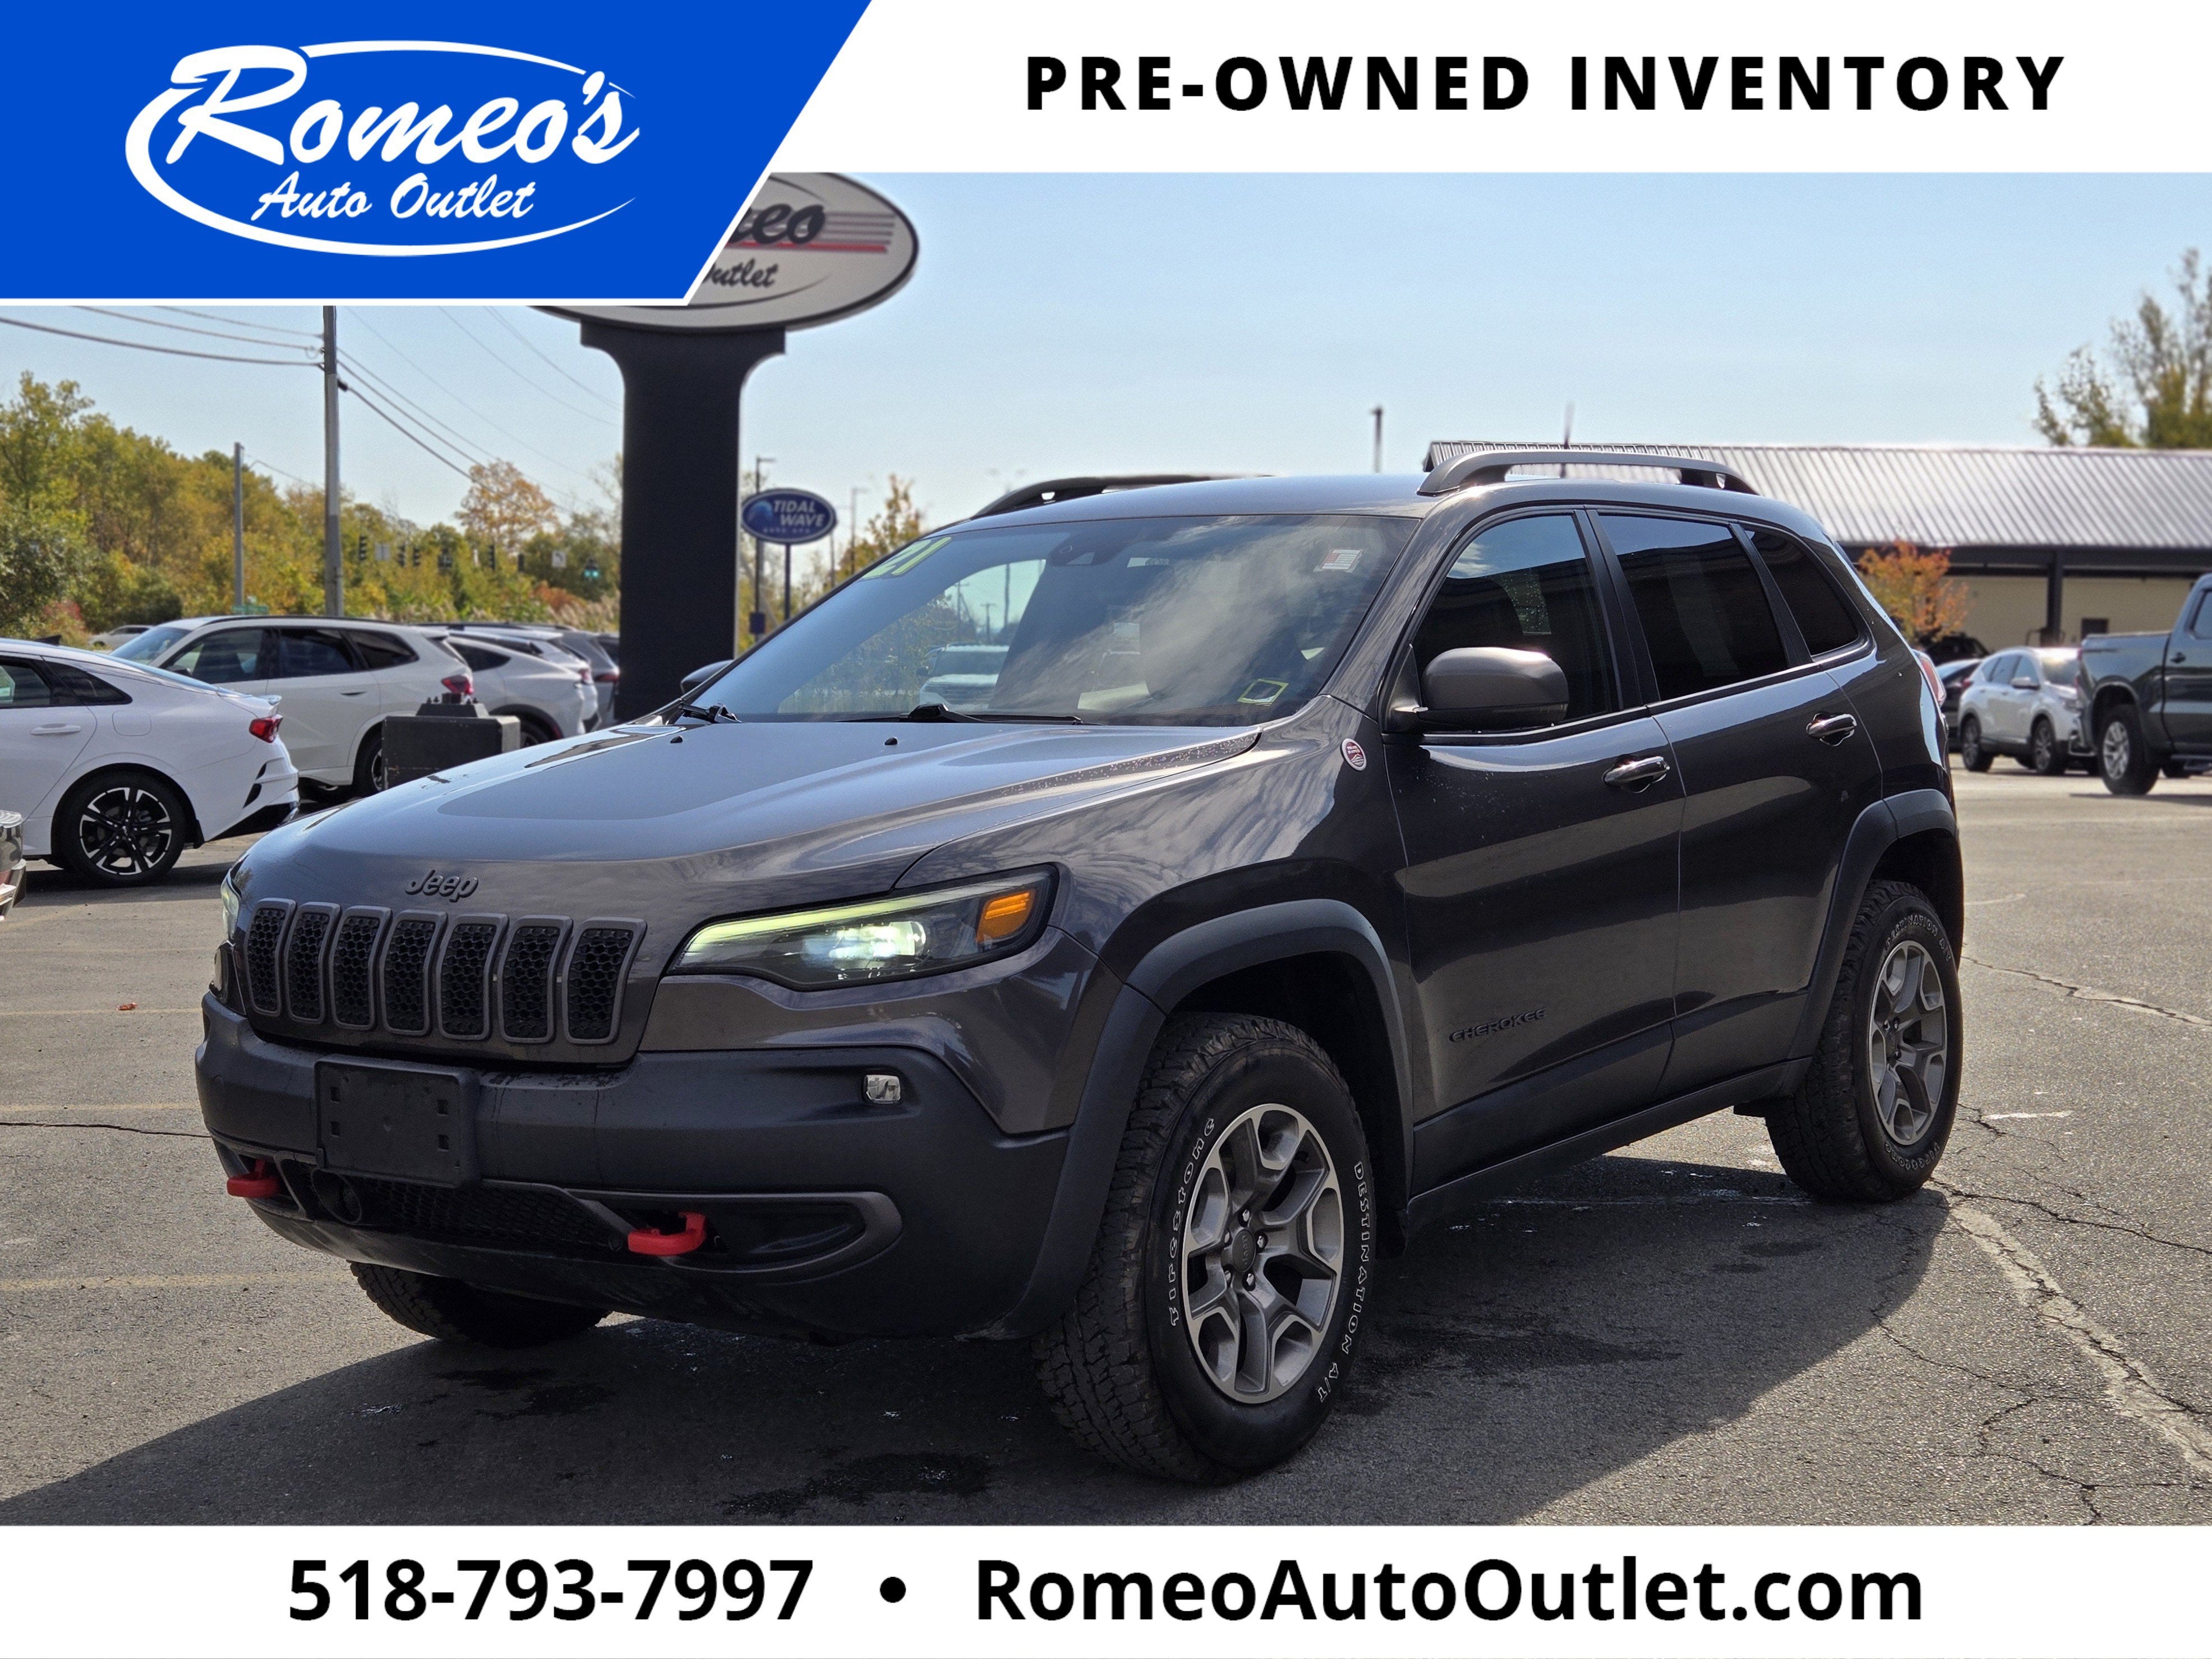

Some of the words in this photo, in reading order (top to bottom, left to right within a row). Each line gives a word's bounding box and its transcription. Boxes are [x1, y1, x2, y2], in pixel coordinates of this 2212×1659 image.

[774, 500, 815, 513] TIDAL
[780, 513, 825, 527] WAVE
[405, 869, 478, 903] Jeep
[1449, 1008, 1546, 1042] CHEROKEE
[1342, 1161, 1370, 1354] DESTINATION
[1317, 1362, 1339, 1402] A/T
